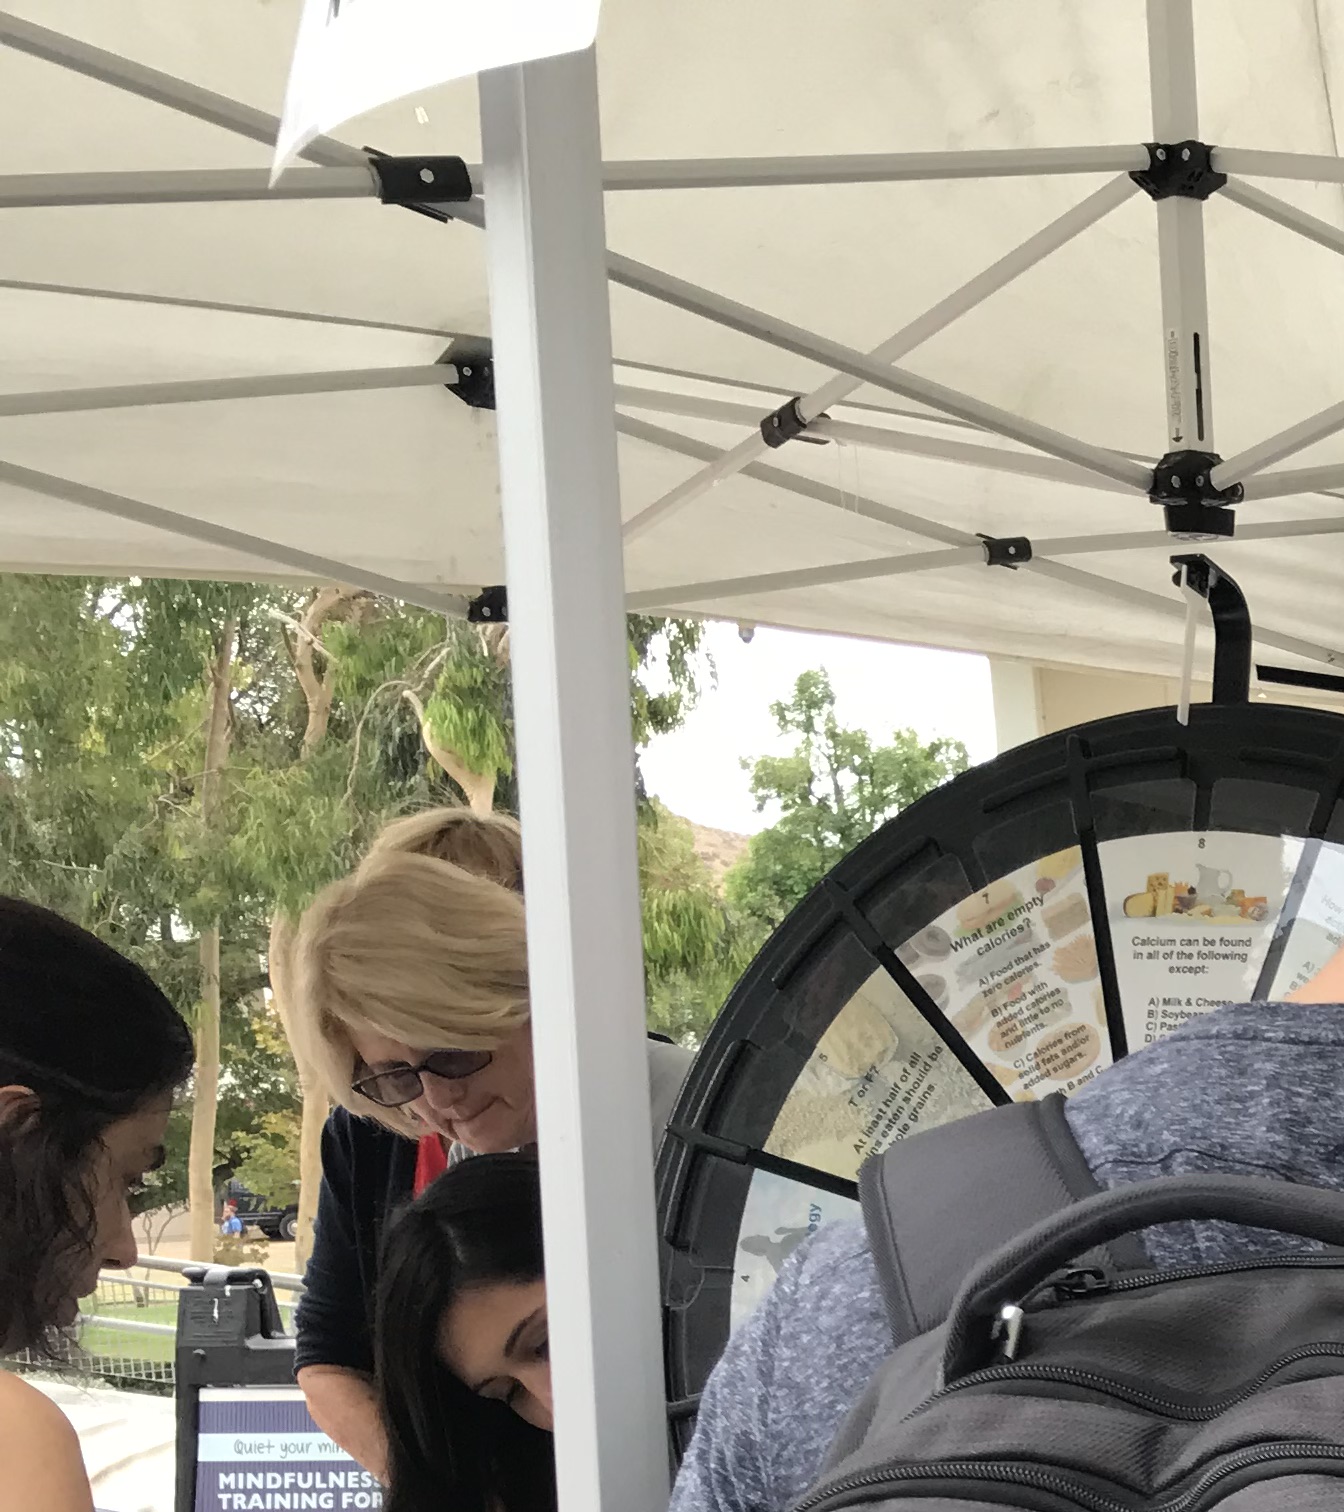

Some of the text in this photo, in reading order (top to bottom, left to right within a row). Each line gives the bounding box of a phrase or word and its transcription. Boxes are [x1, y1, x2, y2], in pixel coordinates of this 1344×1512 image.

[1197, 837, 1206, 849] 8
[950, 894, 1045, 952] What are empty
[976, 916, 1032, 957] calories?
[1131, 935, 1252, 947] Calcium can be found
[990, 961, 1014, 981] Food
[1014, 951, 1033, 967] that
[1033, 940, 1052, 956] has
[1133, 949, 1248, 963] in all of the following
[1168, 964, 1209, 975] except:
[982, 983, 1003, 998] zero
[1002, 993, 1027, 1011] Food
[1027, 980, 1049, 997] with
[1161, 997, 1182, 1007] Milk
[1184, 997, 1193, 1007] &
[996, 987, 1062, 1028] added calories
[1000, 998, 1065, 1039] and little to no
[1025, 1038, 1064, 1062] Calories
[1064, 1024, 1087, 1041] from
[818, 1053, 828, 1062] 5
[1018, 1061, 1040, 1080] solid
[1041, 1052, 1060, 1067] fats
[1023, 1068, 1052, 1091] added
[1078, 1071, 1095, 1086] and
[848, 1097, 858, 1109] T
[856, 1085, 870, 1099] or
[853, 1051, 922, 1155] At least half of all
[880, 1105, 906, 1139] eaten
[902, 1060, 933, 1105] should
[927, 1044, 944, 1063] be
[233, 1438, 276, 1456] Quiet
[279, 1441, 313, 1459] your
[217, 1491, 383, 1511] TRAINING FOR
